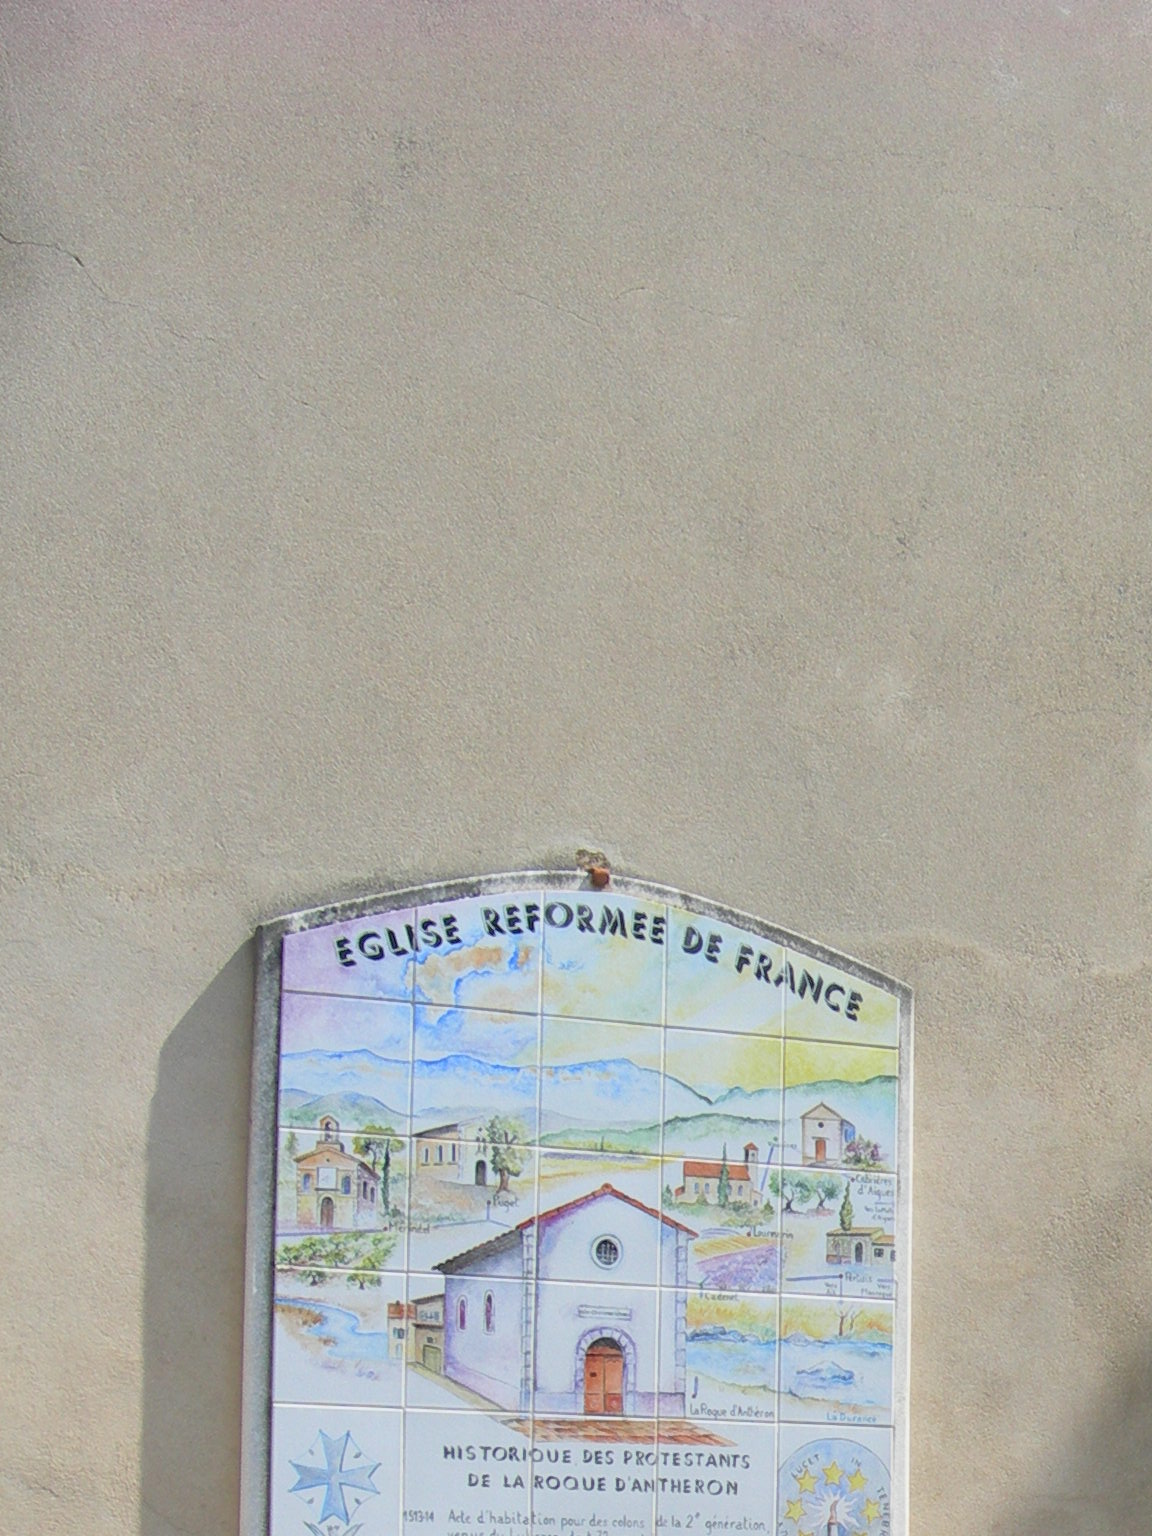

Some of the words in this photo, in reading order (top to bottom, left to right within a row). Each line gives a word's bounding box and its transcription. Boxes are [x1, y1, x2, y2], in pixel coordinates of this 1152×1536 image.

[334, 913, 462, 968] EGLISE
[480, 900, 668, 945] REFORMEE
[681, 925, 722, 964] DE
[732, 943, 864, 1022] FRANCE
[443, 1445, 572, 1464] HISTORIQUE
[582, 1449, 615, 1466] DES
[623, 1450, 751, 1470] PROTESTANTS
[790, 1453, 820, 1480] LUCET
[850, 1457, 862, 1468] IN
[467, 1473, 491, 1488] DE
[503, 1474, 525, 1489] LA
[533, 1475, 607, 1492] ROQUE
[614, 1476, 739, 1496] D'ANTHERON
[447, 1509, 471, 1525] Acte
[476, 1509, 556, 1526] d'habitation
[560, 1515, 585, 1531] pour
[588, 1513, 608, 1528] des
[611, 1514, 645, 1530] colons
[655, 1514, 669, 1528] de
[671, 1514, 682, 1528] la
